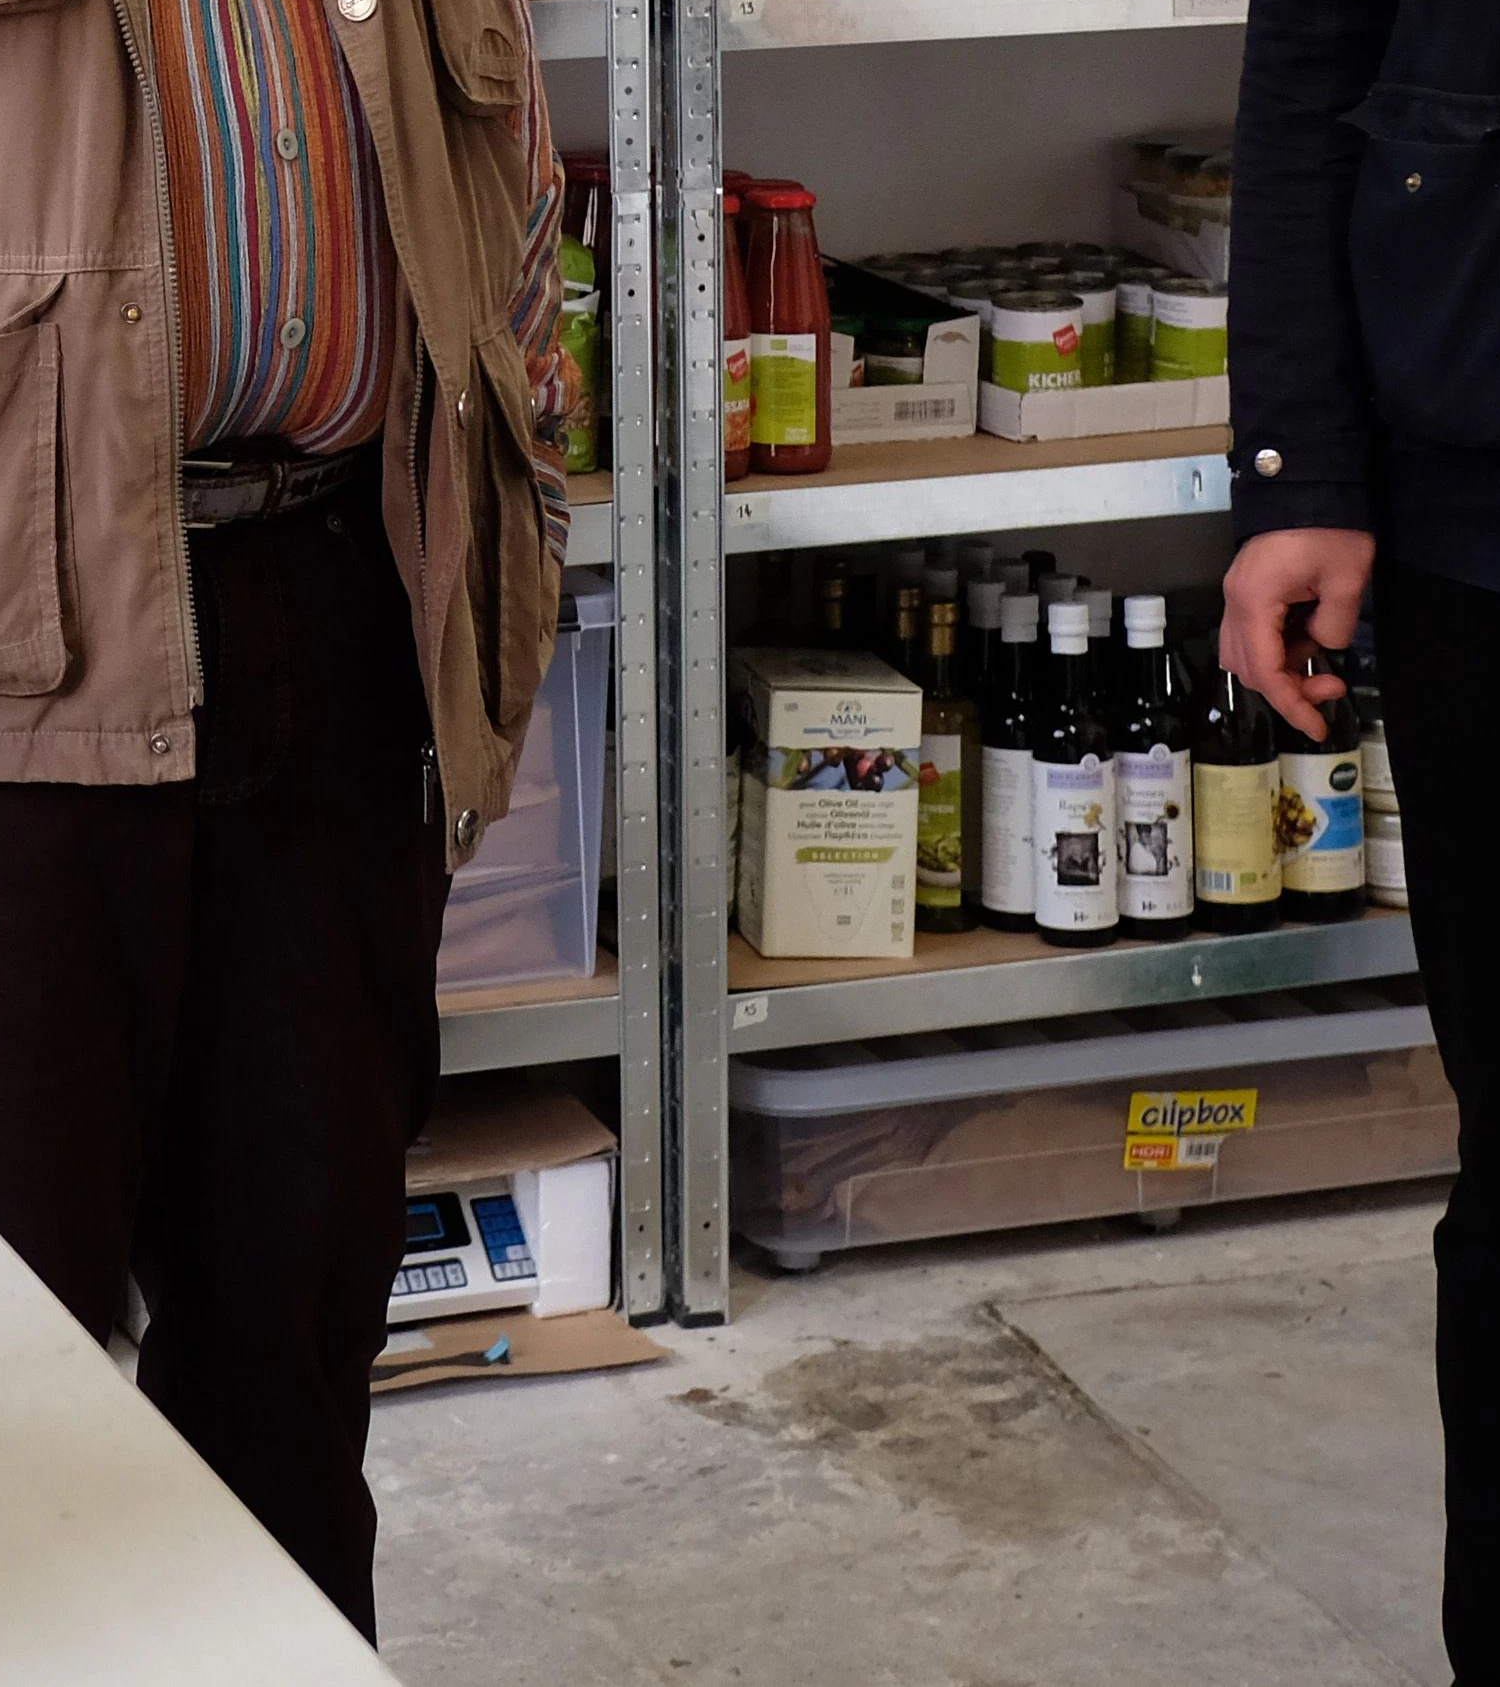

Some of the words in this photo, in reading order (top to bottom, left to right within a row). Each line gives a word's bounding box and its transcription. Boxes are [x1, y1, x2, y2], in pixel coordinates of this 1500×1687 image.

[739, 1, 755, 16] 13
[1028, 369, 1082, 388] KICHER
[829, 713, 868, 726] MANI
[811, 851, 880, 861] SELECTION
[1141, 1096, 1245, 1137] clipbox
